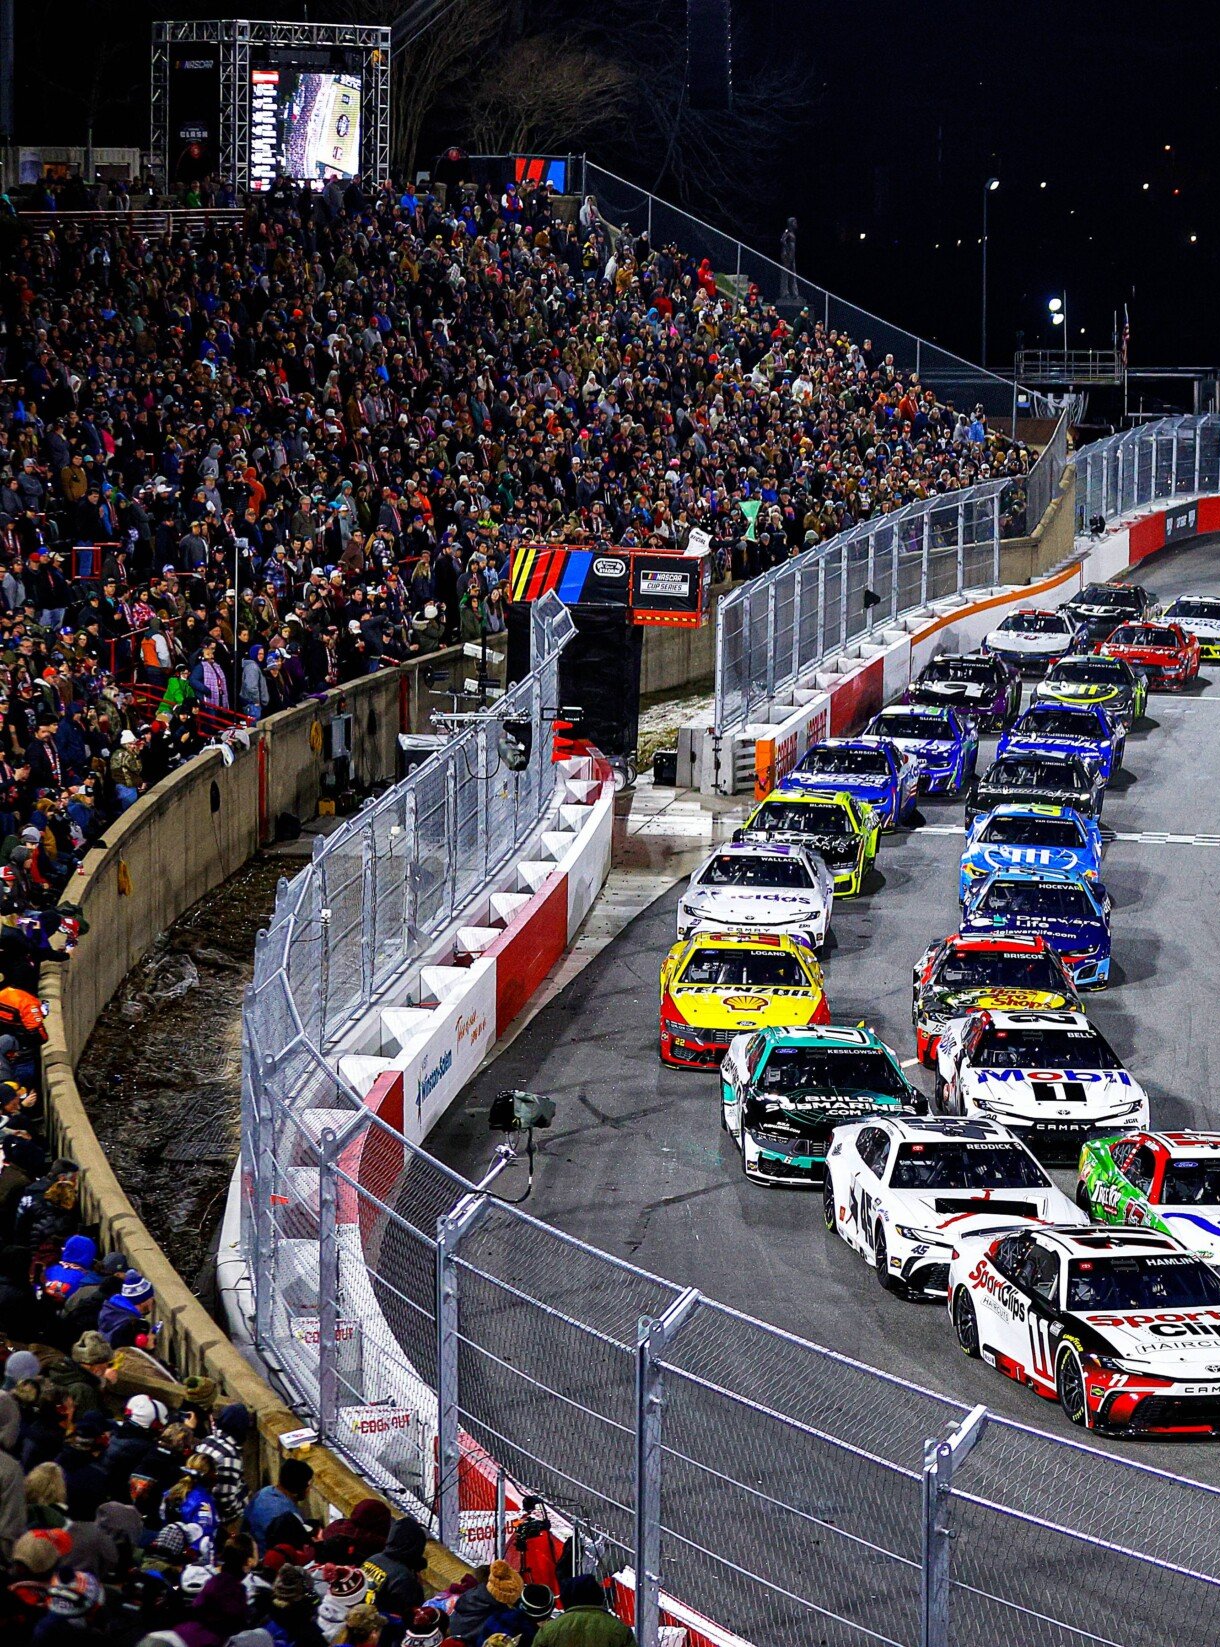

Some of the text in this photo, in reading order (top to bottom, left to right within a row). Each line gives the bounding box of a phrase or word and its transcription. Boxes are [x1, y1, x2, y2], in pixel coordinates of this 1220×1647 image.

[184, 60, 214, 69] NASCAR
[180, 130, 208, 138] CLASH
[656, 574, 682, 582] NASCAR
[1011, 736, 1098, 751] FASTENAL
[1016, 916, 1100, 927] Delaware
[1016, 920, 1050, 928] Life
[994, 929, 1077, 939] delawarelife.com
[1004, 952, 1045, 960] BRISCOE
[676, 986, 814, 998] PENNZOIL
[991, 999, 1052, 1009] Shops
[675, 1038, 685, 1046] 22
[978, 1069, 1132, 1087] Mobil
[1046, 1082, 1067, 1100] 1
[765, 1102, 917, 1115] SUBMARINES
[784, 1156, 791, 1164] 6
[910, 1245, 930, 1255] 45
[1146, 1258, 1193, 1267] HAMLIN
[968, 1260, 1025, 1323] Sport Clips
[983, 1297, 1010, 1323] HAIRCUTS
[1028, 1311, 1055, 1378] 11
[1063, 1334, 1084, 1352] GOODYEAR
[1108, 1373, 1130, 1387] 11
[467, 1524, 497, 1543] COO
